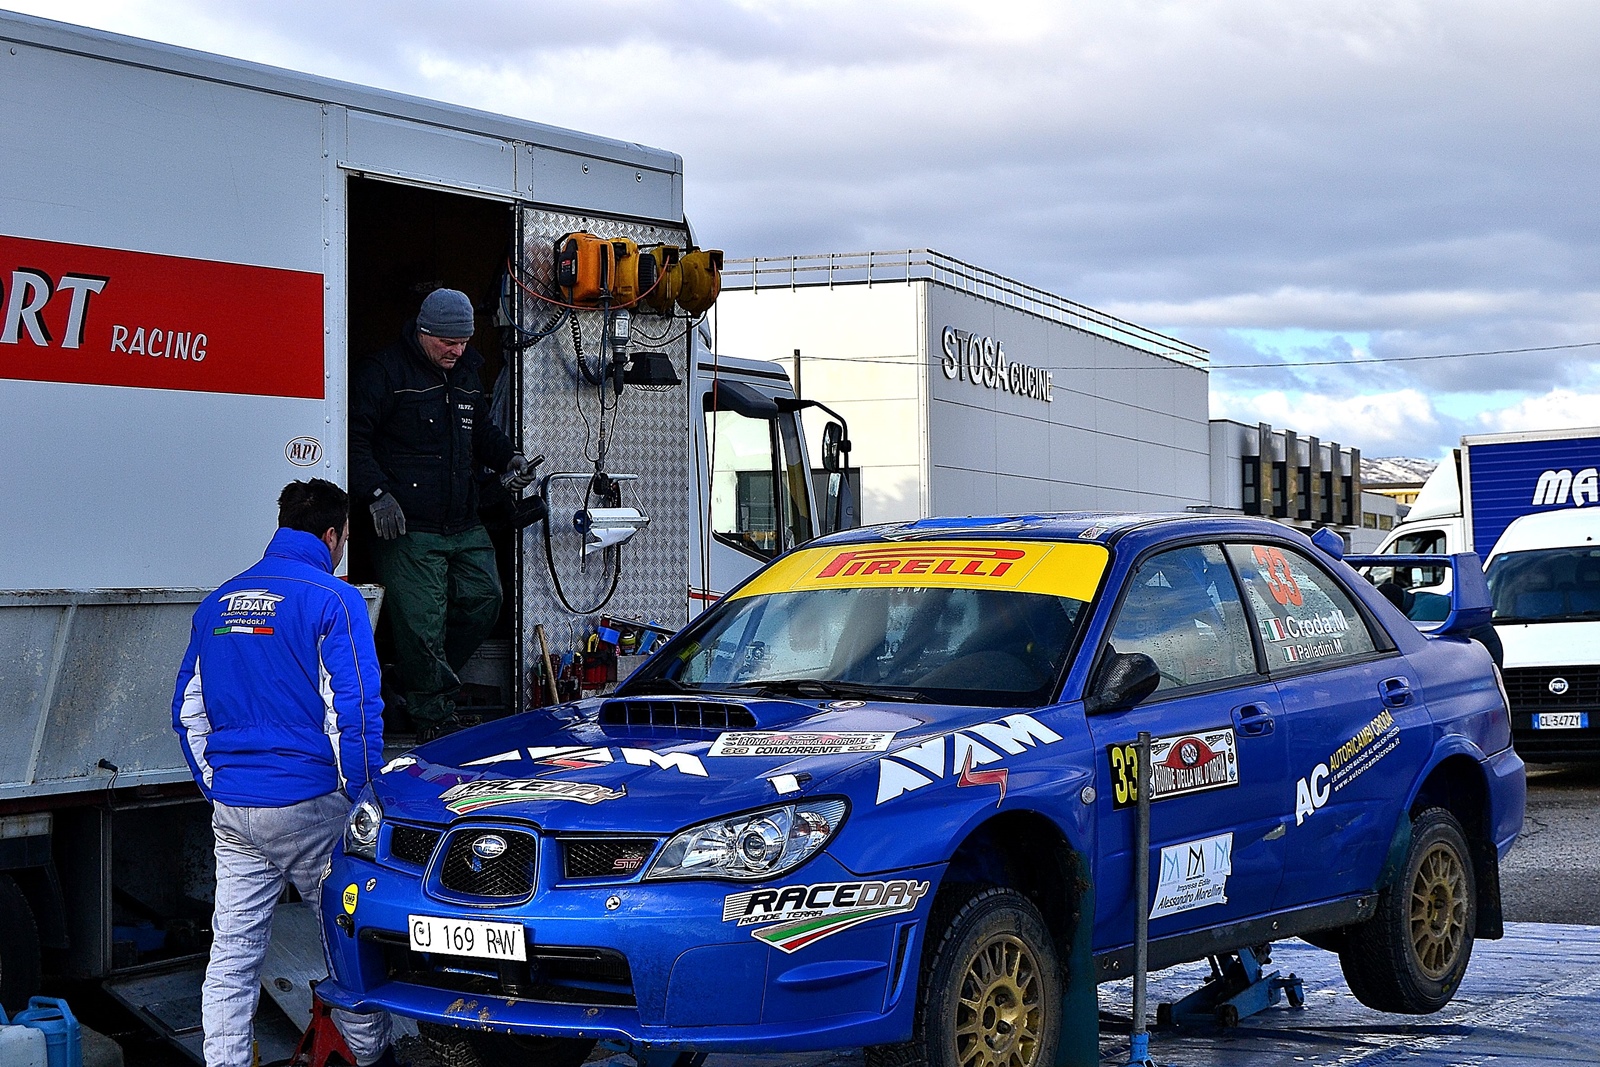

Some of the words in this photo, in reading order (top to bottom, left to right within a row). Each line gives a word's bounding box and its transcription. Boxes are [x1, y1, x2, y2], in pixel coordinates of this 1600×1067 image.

[0, 267, 110, 350] RT
[110, 324, 208, 362] RACING
[942, 325, 1008, 391] STOSA
[1009, 362, 1053, 402] CUCINE
[290, 442, 318, 460] MPI
[816, 547, 1026, 579] PIRELLI
[1252, 546, 1303, 606] 33
[218, 589, 285, 611] TEDAK
[1285, 610, 1349, 638] Croda.M
[1297, 639, 1344, 659] Palladini.M
[755, 746, 842, 755] CONCORRENTE
[1330, 724, 1375, 772] AUTORICAMBI
[1371, 709, 1395, 737] CRODA
[1112, 745, 1138, 804] 33
[1153, 763, 1176, 793] RONDE
[1176, 768, 1194, 789] DELLA
[1194, 765, 1205, 786] VAL
[1296, 763, 1331, 826] AC
[744, 881, 930, 915] RACEDAY
[1157, 891, 1194, 910] Alessandro
[740, 913, 782, 924] RONDE
[786, 910, 823, 919] TERRA
[413, 921, 431, 947] CJ
[443, 925, 475, 951] 169
[487, 928, 515, 956] RW
